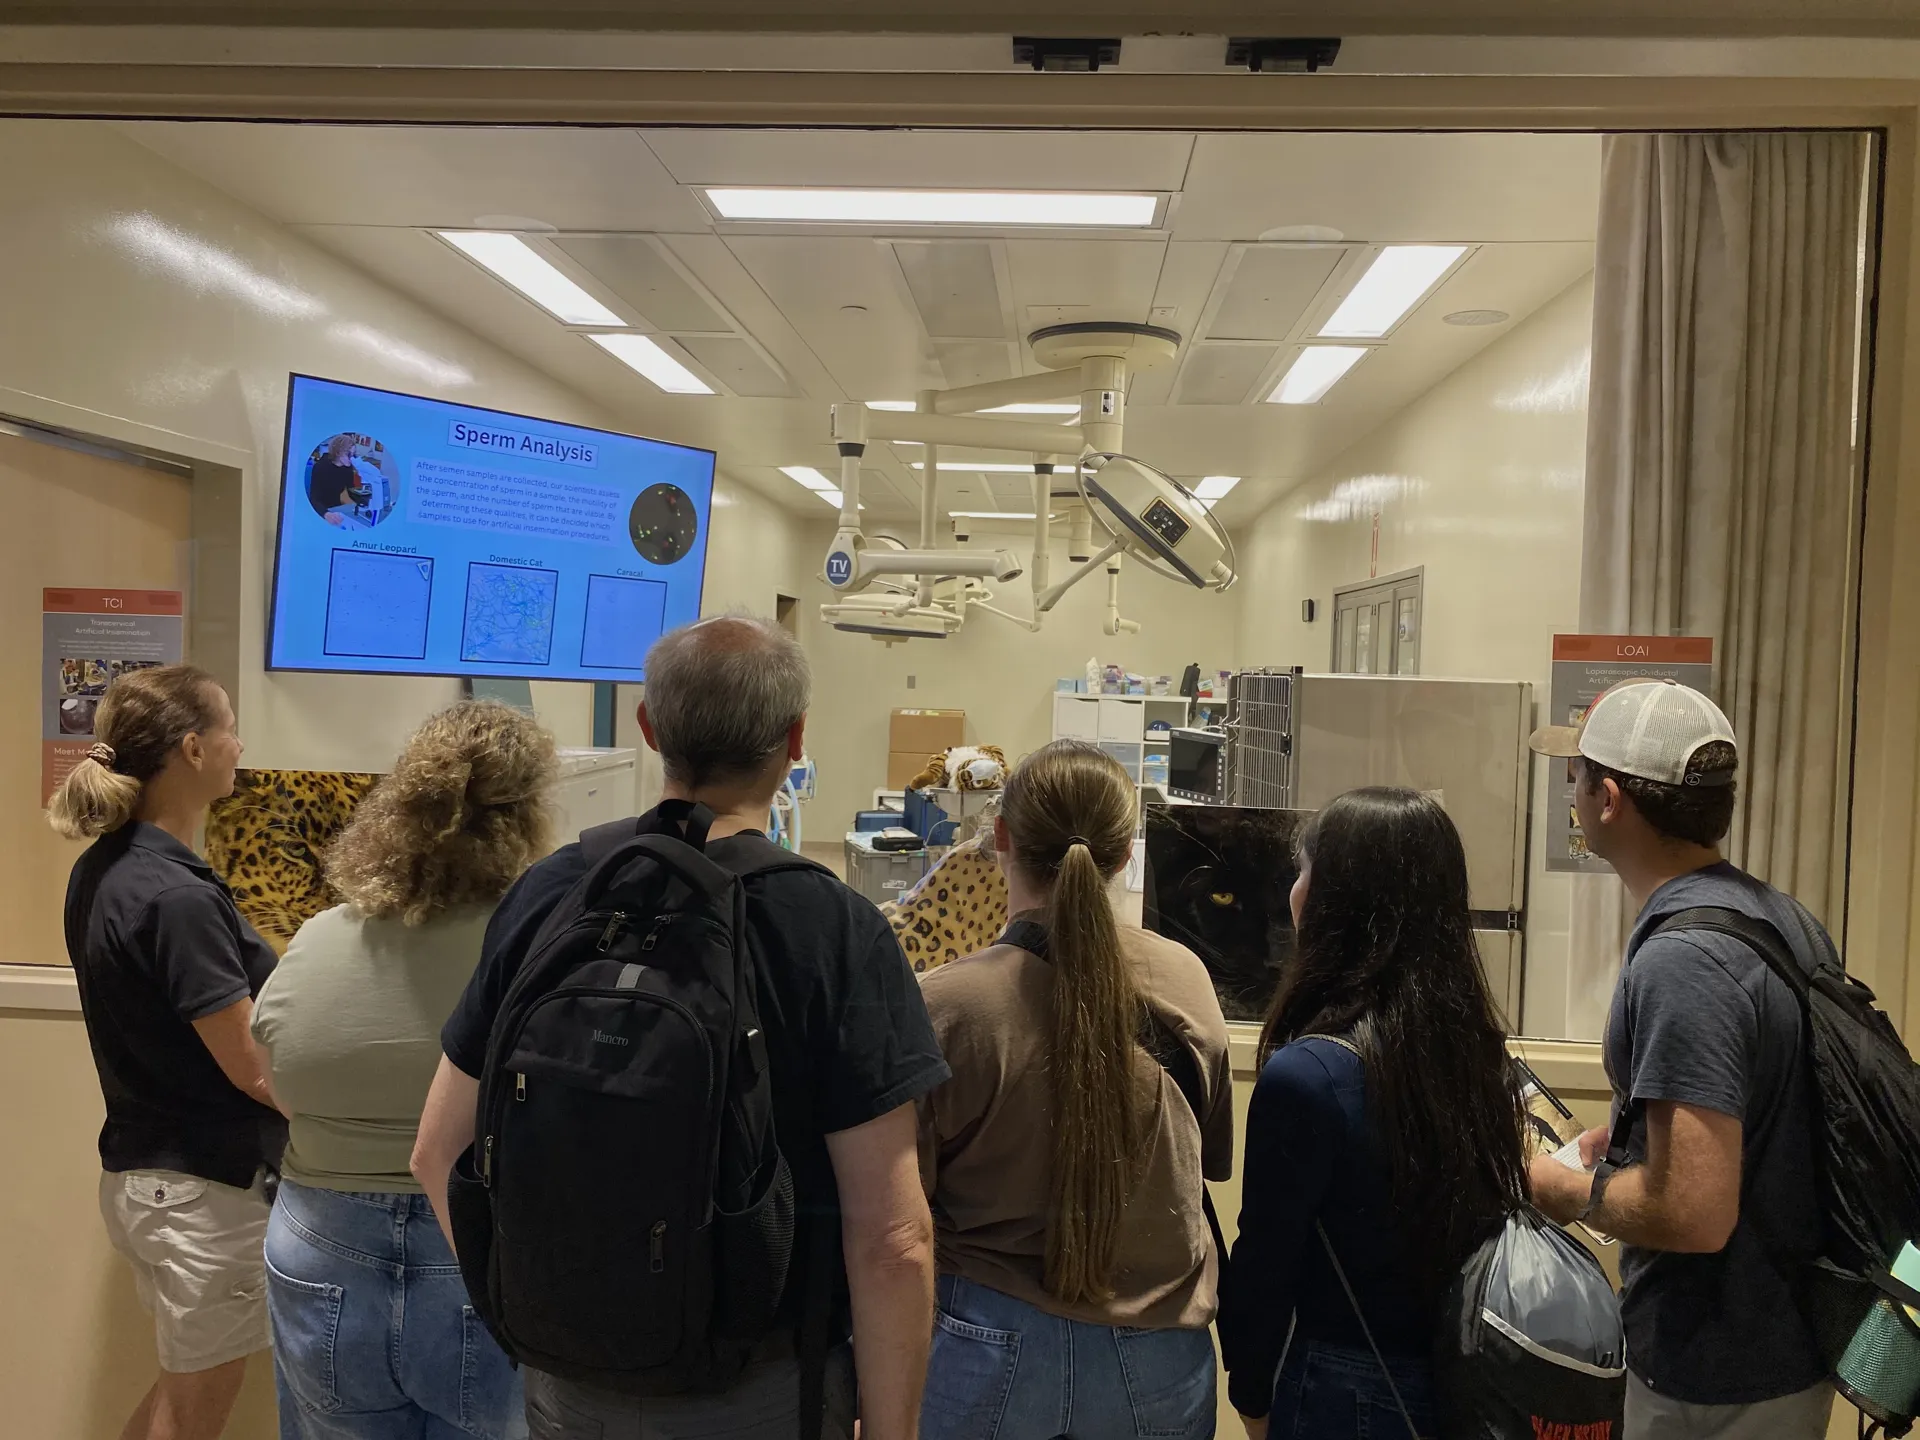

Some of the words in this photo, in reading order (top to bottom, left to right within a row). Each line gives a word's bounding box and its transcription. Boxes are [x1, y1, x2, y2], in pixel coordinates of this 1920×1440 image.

[454, 424, 515, 448] Sperm
[520, 436, 593, 462] Analysis
[416, 462, 437, 471] After
[438, 465, 464, 474] semen
[466, 468, 498, 480] samples
[513, 476, 550, 488] collected,
[418, 474, 432, 482] the
[434, 477, 489, 490] concentration
[490, 484, 499, 492] of
[500, 487, 524, 496] sperm
[416, 486, 430, 494] the
[432, 488, 459, 500] sperm,
[460, 492, 475, 500] and
[476, 494, 490, 502] the
[491, 497, 522, 507] number
[522, 500, 530, 508] of
[531, 502, 554, 512] sperm
[556, 504, 570, 513] that
[571, 508, 582, 516] are
[421, 499, 470, 514] determining
[471, 505, 492, 515] these
[536, 514, 549, 522] can
[550, 515, 560, 523] be
[560, 517, 588, 528] decided
[418, 511, 452, 522] samples
[452, 514, 461, 522] to
[478, 518, 489, 526] for
[491, 520, 522, 530] artificial
[523, 524, 569, 536] insemination
[352, 540, 378, 550] Amur
[380, 542, 416, 554] Leopard
[490, 554, 528, 566] Domestic
[530, 558, 544, 567] Cat
[830, 560, 848, 573] TV
[616, 568, 644, 578] Caracal
[102, 597, 123, 609] TCI
[1616, 645, 1649, 657] LOAI
[54, 748, 75, 756] Meet
[592, 1029, 629, 1047] Mancro
